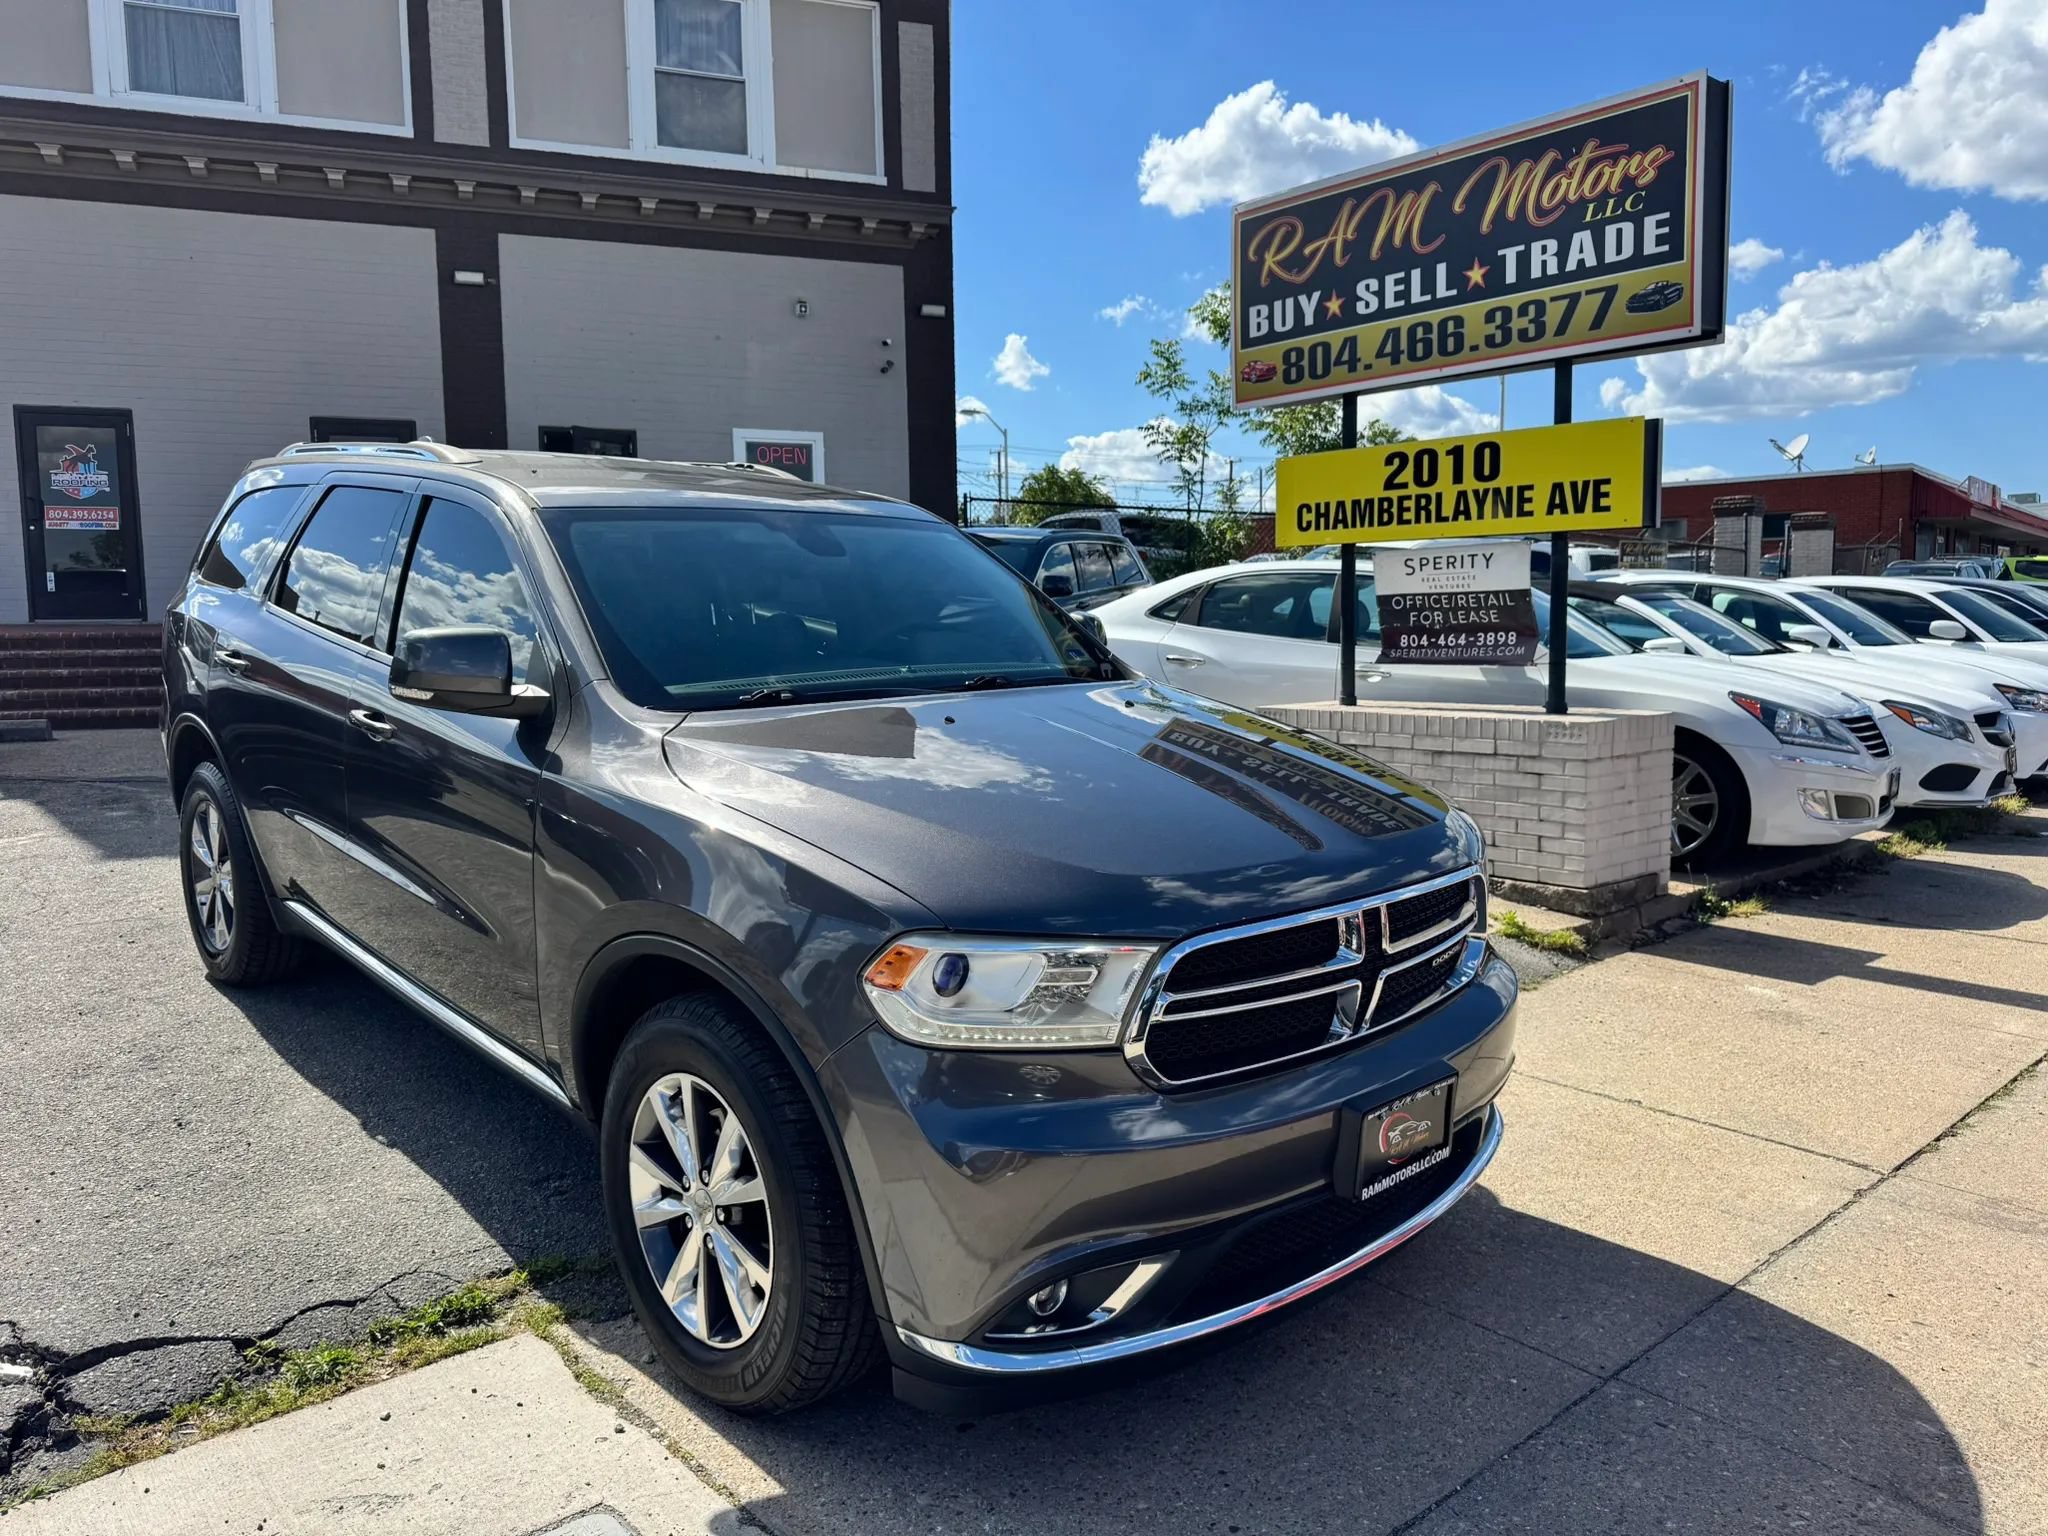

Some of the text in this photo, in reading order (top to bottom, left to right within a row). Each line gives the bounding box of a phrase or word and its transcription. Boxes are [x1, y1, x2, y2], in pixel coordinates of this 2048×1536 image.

[1248, 138, 1675, 288] RAM Motors
[1582, 191, 1646, 223] LLC
[1249, 211, 1671, 338] BUY SELL TRADE
[1282, 284, 1619, 386] 804.466.3377
[757, 446, 807, 465] OPEN
[1383, 441, 1501, 492] 2010
[48, 509, 114, 520] 804.395.6254
[1297, 478, 1612, 533] CHAMBERLAYNE AVE
[1404, 552, 1494, 576] SPERITY
[1446, 574, 1477, 582] ESTATE
[1392, 593, 1516, 610] OFFICE/RETAIL
[1410, 610, 1500, 627] FOR LEASE
[1400, 631, 1517, 647] 804-464-3898
[1390, 646, 1525, 658] SPERITYVENTURES.COM
[1361, 1147, 1450, 1201] RAMMOTORSLLC.COM
